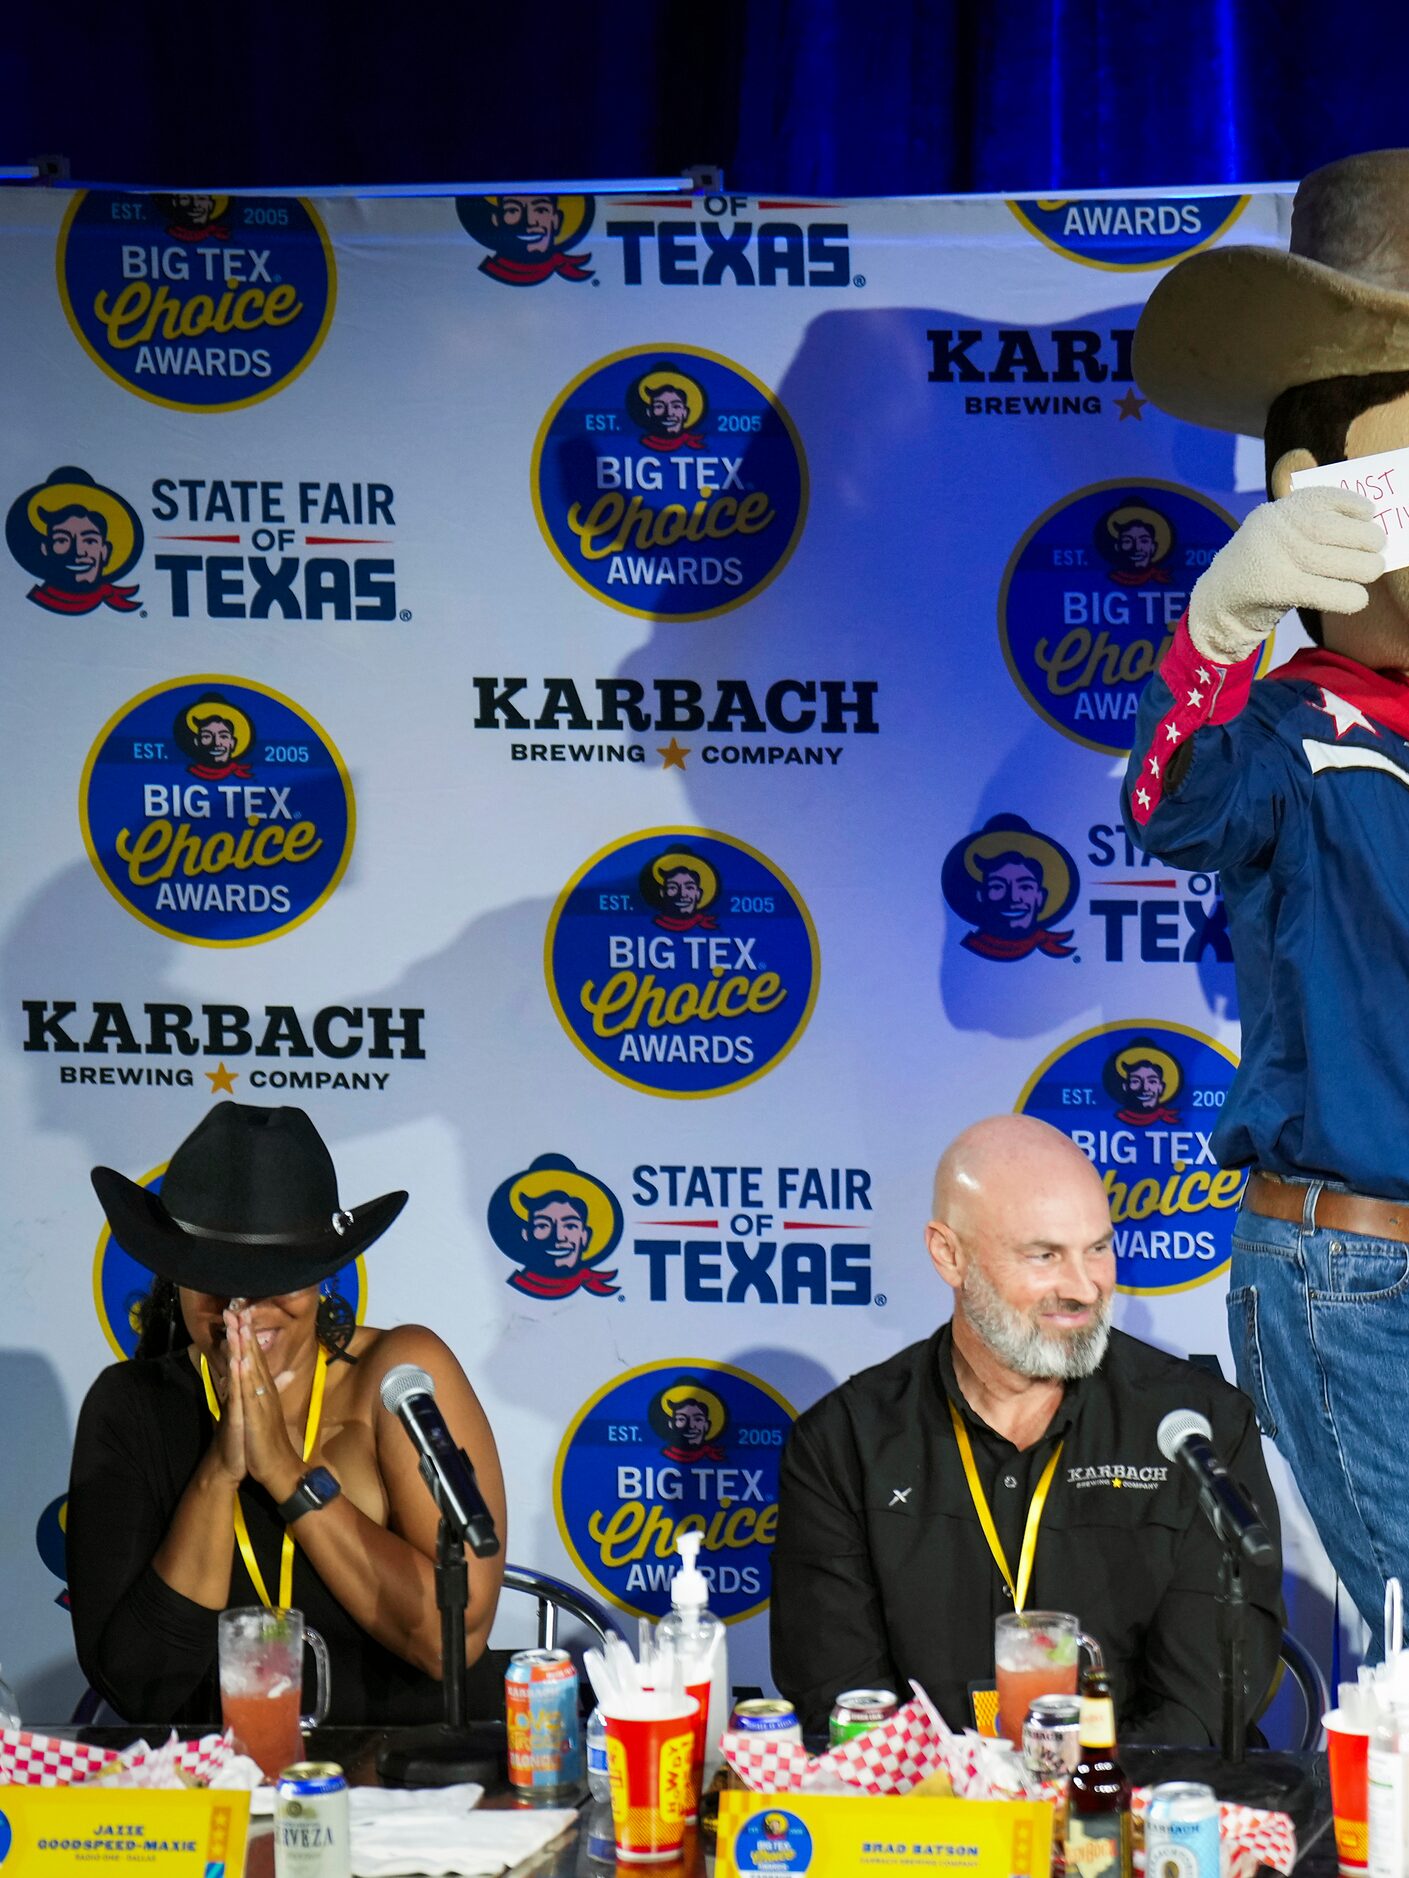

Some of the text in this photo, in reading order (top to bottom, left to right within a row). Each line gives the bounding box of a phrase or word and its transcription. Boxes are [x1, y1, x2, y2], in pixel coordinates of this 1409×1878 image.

[111, 203, 289, 226] EST. 2005
[704, 196, 748, 216] OF
[1062, 204, 1202, 237] AWARDS
[122, 246, 272, 284] BIG TEX
[607, 222, 850, 287] TEXAS
[94, 279, 303, 350] Choice
[134, 345, 272, 377] AWARDS
[964, 396, 1101, 415] BREWING
[585, 414, 762, 433] EST. 2005
[596, 456, 744, 491] BIG TEX
[1340, 469, 1395, 500] OST
[151, 479, 396, 526] STATE FAIR
[567, 486, 776, 560] Choice
[251, 529, 296, 551] OF
[606, 557, 743, 586] AWARDS
[1054, 551, 1216, 566] EST. 200
[155, 554, 397, 621] TEXAS
[1064, 592, 1192, 624] BIG TE
[1034, 622, 1175, 695] Choi
[472, 677, 879, 734] KARBACH
[1074, 693, 1139, 720] AWA
[134, 743, 309, 762] EST. 2005
[511, 743, 844, 765] BREWING COMPANY
[144, 784, 292, 820] BIG TEX
[116, 814, 323, 886] Choice
[155, 884, 291, 913] AWARDS
[599, 895, 774, 913] EST. 2005
[1090, 900, 1235, 963] TEX
[608, 936, 756, 970] BIG TEX
[580, 965, 787, 1038] Choice
[22, 1000, 426, 1060] KARBACH
[619, 1034, 754, 1063] AWARDS
[60, 1066, 390, 1090] BREWING COMPANY
[1062, 1089, 1226, 1107] EST. 200
[1072, 1130, 1217, 1165] BIG TEX
[632, 1165, 873, 1211] STATE FAIR
[1102, 1161, 1247, 1223] hoice
[730, 1214, 773, 1236] OF
[1112, 1231, 1216, 1260] WARDS
[633, 1239, 872, 1305] TEXAS
[608, 1425, 782, 1445] EST. 2005
[617, 1466, 764, 1501] BIG TEX
[1067, 1465, 1168, 1482] KARBACH
[1076, 1479, 1158, 1490] BREWING COMPANY
[625, 1564, 761, 1594] AWRDS
[282, 1827, 334, 1848] RVEZA
[862, 1842, 979, 1856] BRAD BATSON
